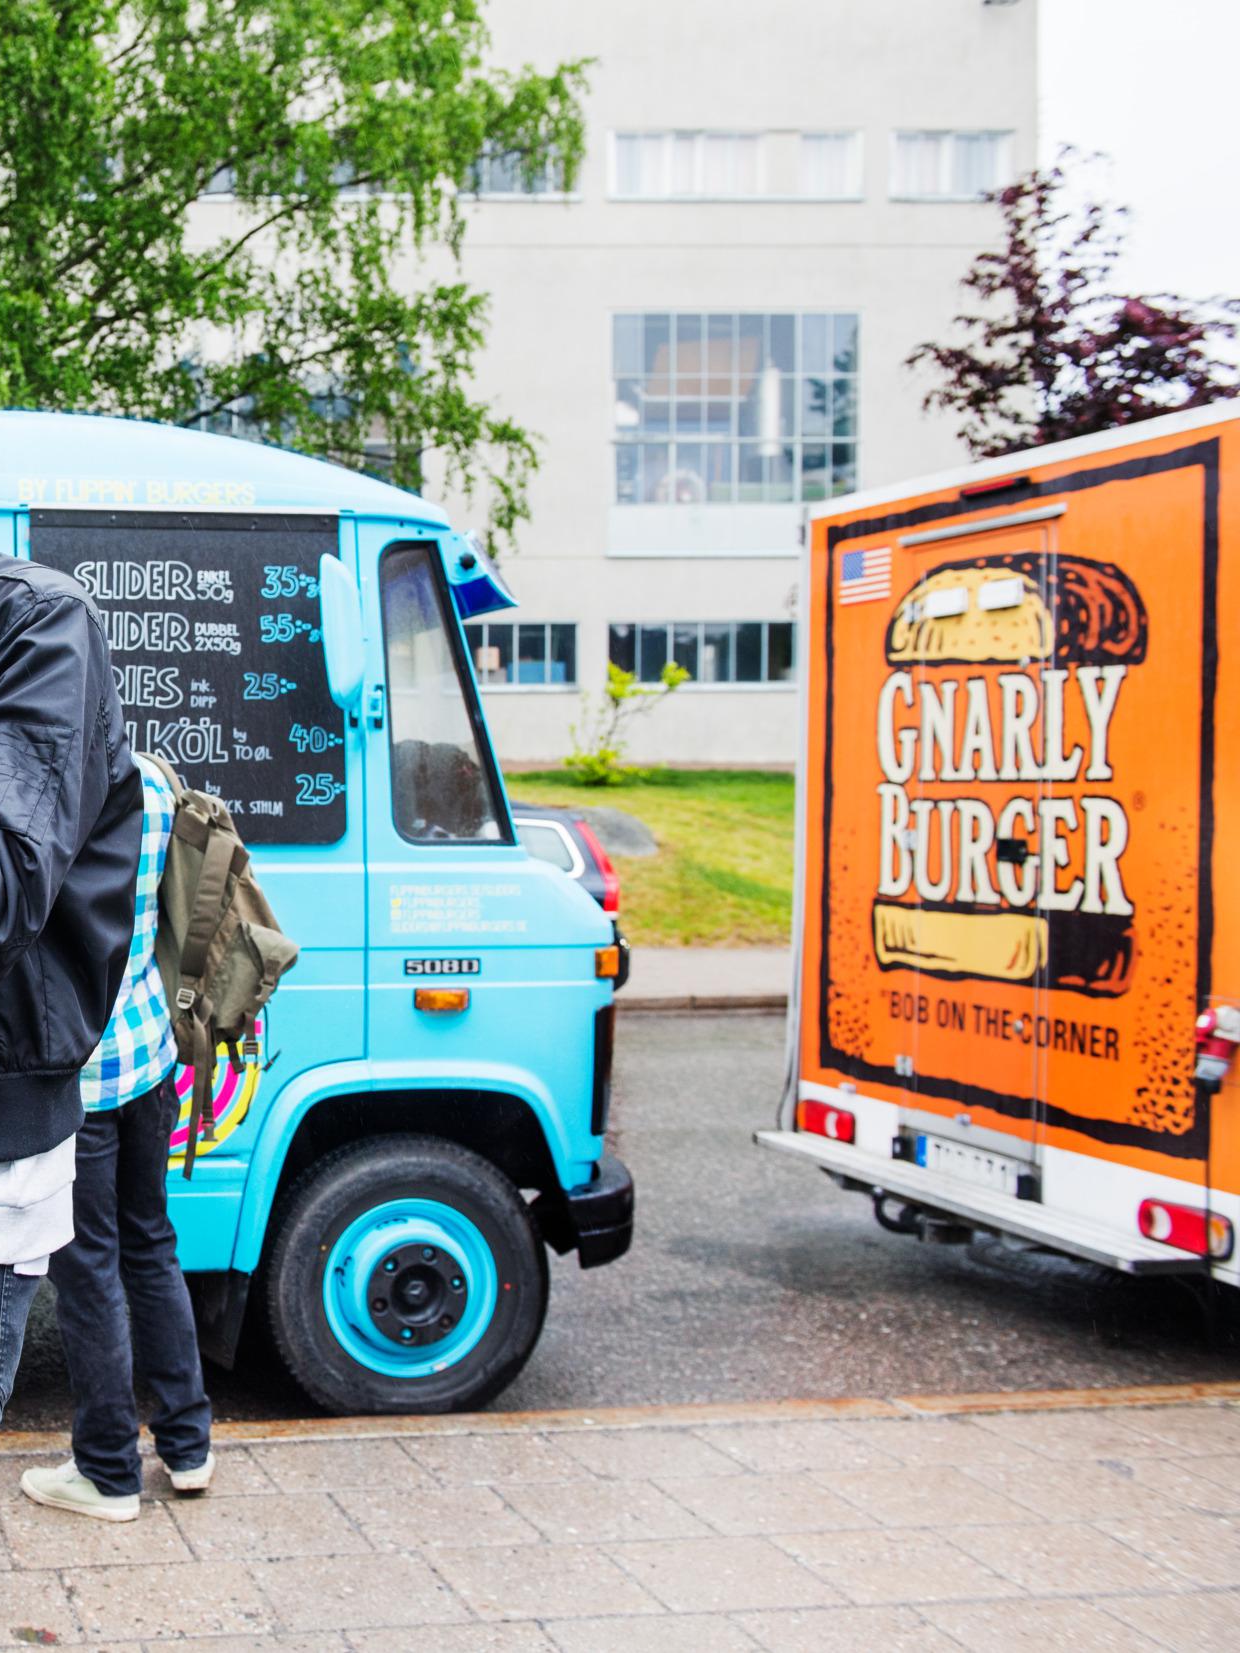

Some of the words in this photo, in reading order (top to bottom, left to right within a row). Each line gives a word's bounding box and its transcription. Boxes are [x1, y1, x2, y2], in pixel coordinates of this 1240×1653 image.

[17, 478, 47, 502] BY
[146, 480, 255, 506] BURGERS
[73, 561, 196, 601] SLIDER
[197, 570, 232, 586] ENKEL
[196, 584, 234, 604] 50g
[98, 609, 192, 653] LIDER
[194, 622, 240, 637] DUBBEL
[190, 695, 217, 709] DIPP
[877, 664, 1127, 784] GNARLY
[233, 727, 248, 743] by
[205, 780, 221, 796] by
[877, 783, 1134, 916] BURGER
[406, 959, 479, 974] 508D
[890, 991, 929, 1024] BOB
[937, 998, 965, 1031] ON
[973, 1004, 1013, 1041] THE
[1021, 1013, 1120, 1061] CORNER
